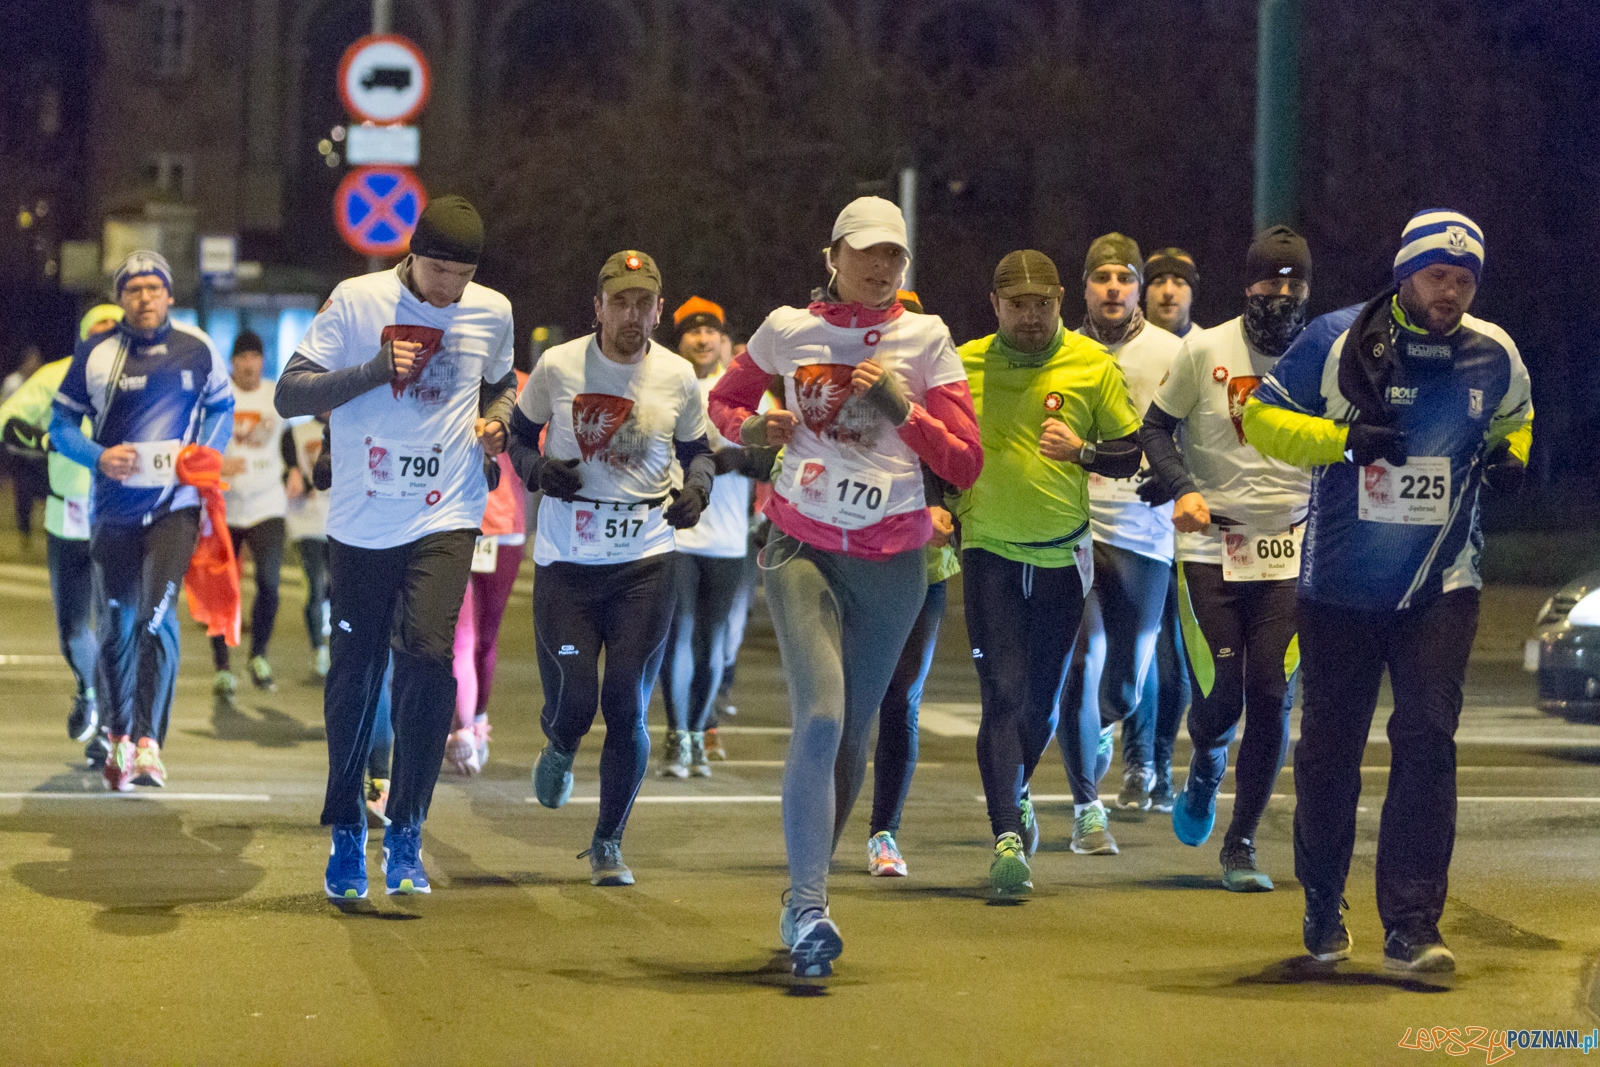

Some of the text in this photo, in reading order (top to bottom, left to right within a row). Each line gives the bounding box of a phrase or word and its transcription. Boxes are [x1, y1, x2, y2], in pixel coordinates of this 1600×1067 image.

[153, 453, 171, 469] 61
[399, 456, 440, 477] 790
[837, 478, 882, 510] 170
[1400, 475, 1445, 499] 225
[605, 518, 643, 538] 517
[476, 541, 492, 554] 14
[1257, 539, 1295, 559] 608
